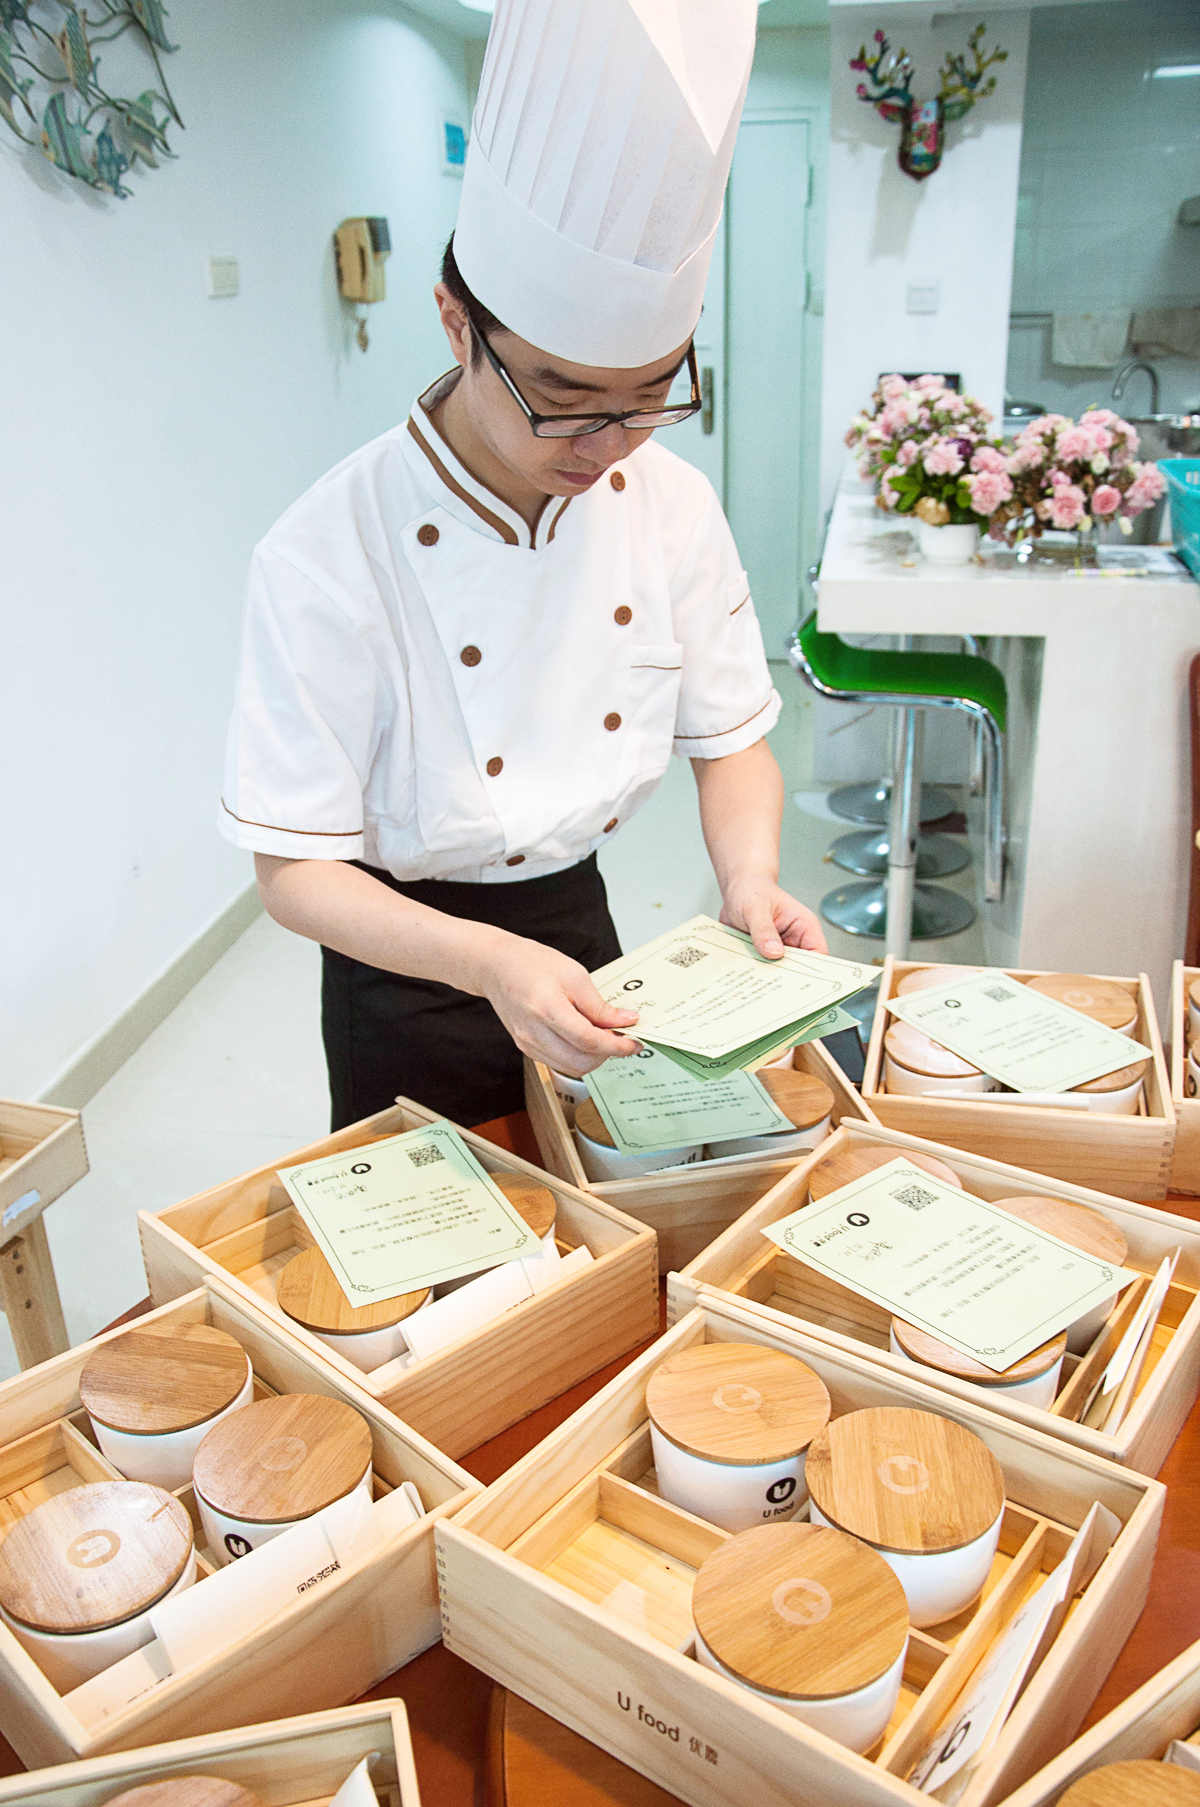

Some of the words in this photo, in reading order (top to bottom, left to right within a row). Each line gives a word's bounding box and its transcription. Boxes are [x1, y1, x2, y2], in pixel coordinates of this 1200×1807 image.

[824, 1229, 843, 1241] food
[763, 1510, 771, 1518] U
[774, 1501, 794, 1516] food
[618, 1691, 630, 1711] U
[637, 1704, 679, 1742] food
